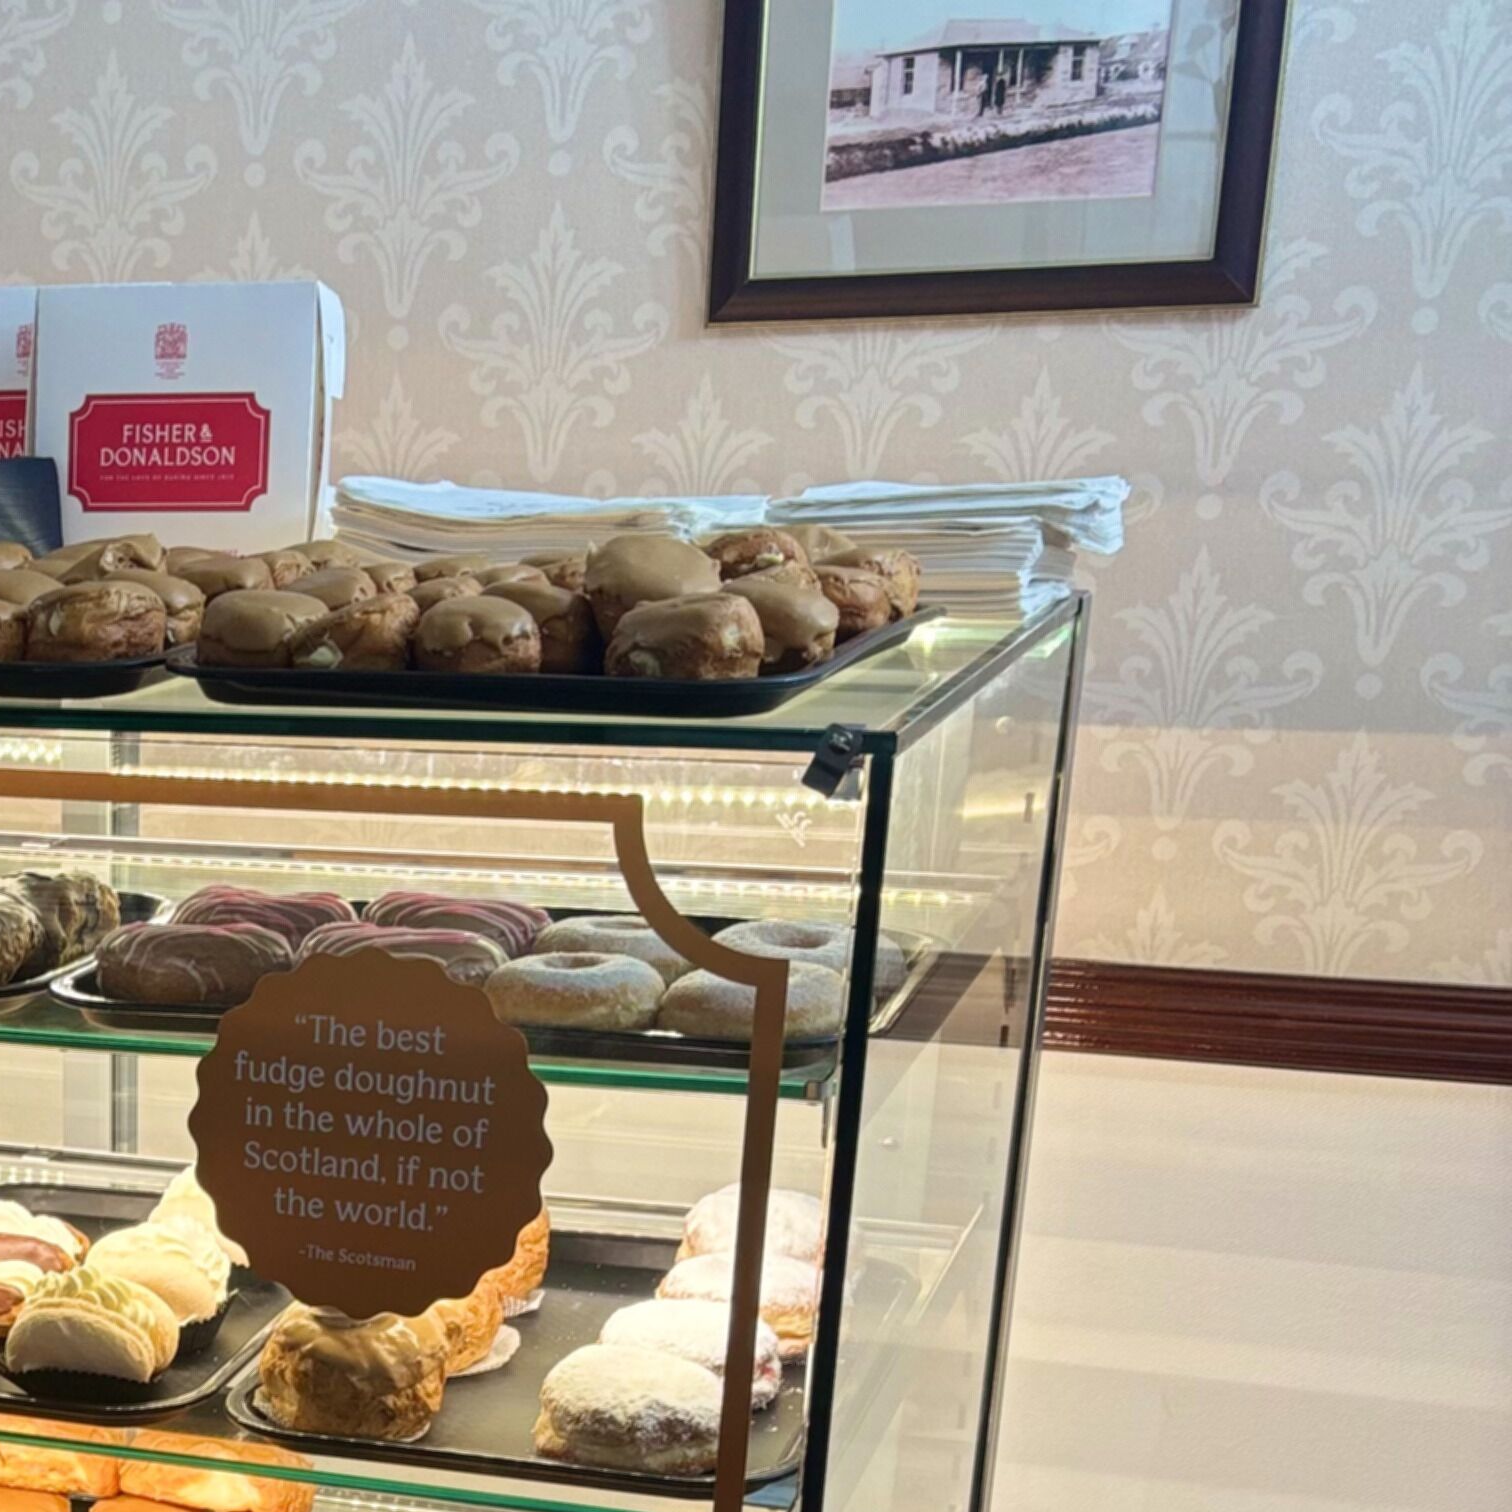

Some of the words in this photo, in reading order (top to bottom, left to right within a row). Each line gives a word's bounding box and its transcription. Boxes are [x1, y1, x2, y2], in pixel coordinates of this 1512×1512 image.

[122, 424, 196, 443] FISHER
[200, 423, 212, 443] &
[100, 445, 236, 468] DONALDSON
[377, 1020, 445, 1055] best
[234, 1050, 325, 1093] fudge
[334, 1063, 496, 1105] doughnut
[245, 1097, 273, 1127] in
[283, 1102, 334, 1133] the
[345, 1110, 443, 1144] whole
[452, 1119, 488, 1149] of
[396, 1156, 421, 1185] if
[428, 1165, 485, 1193] not
[274, 1187, 324, 1219] the
[338, 1249, 417, 1271] Scotsman
